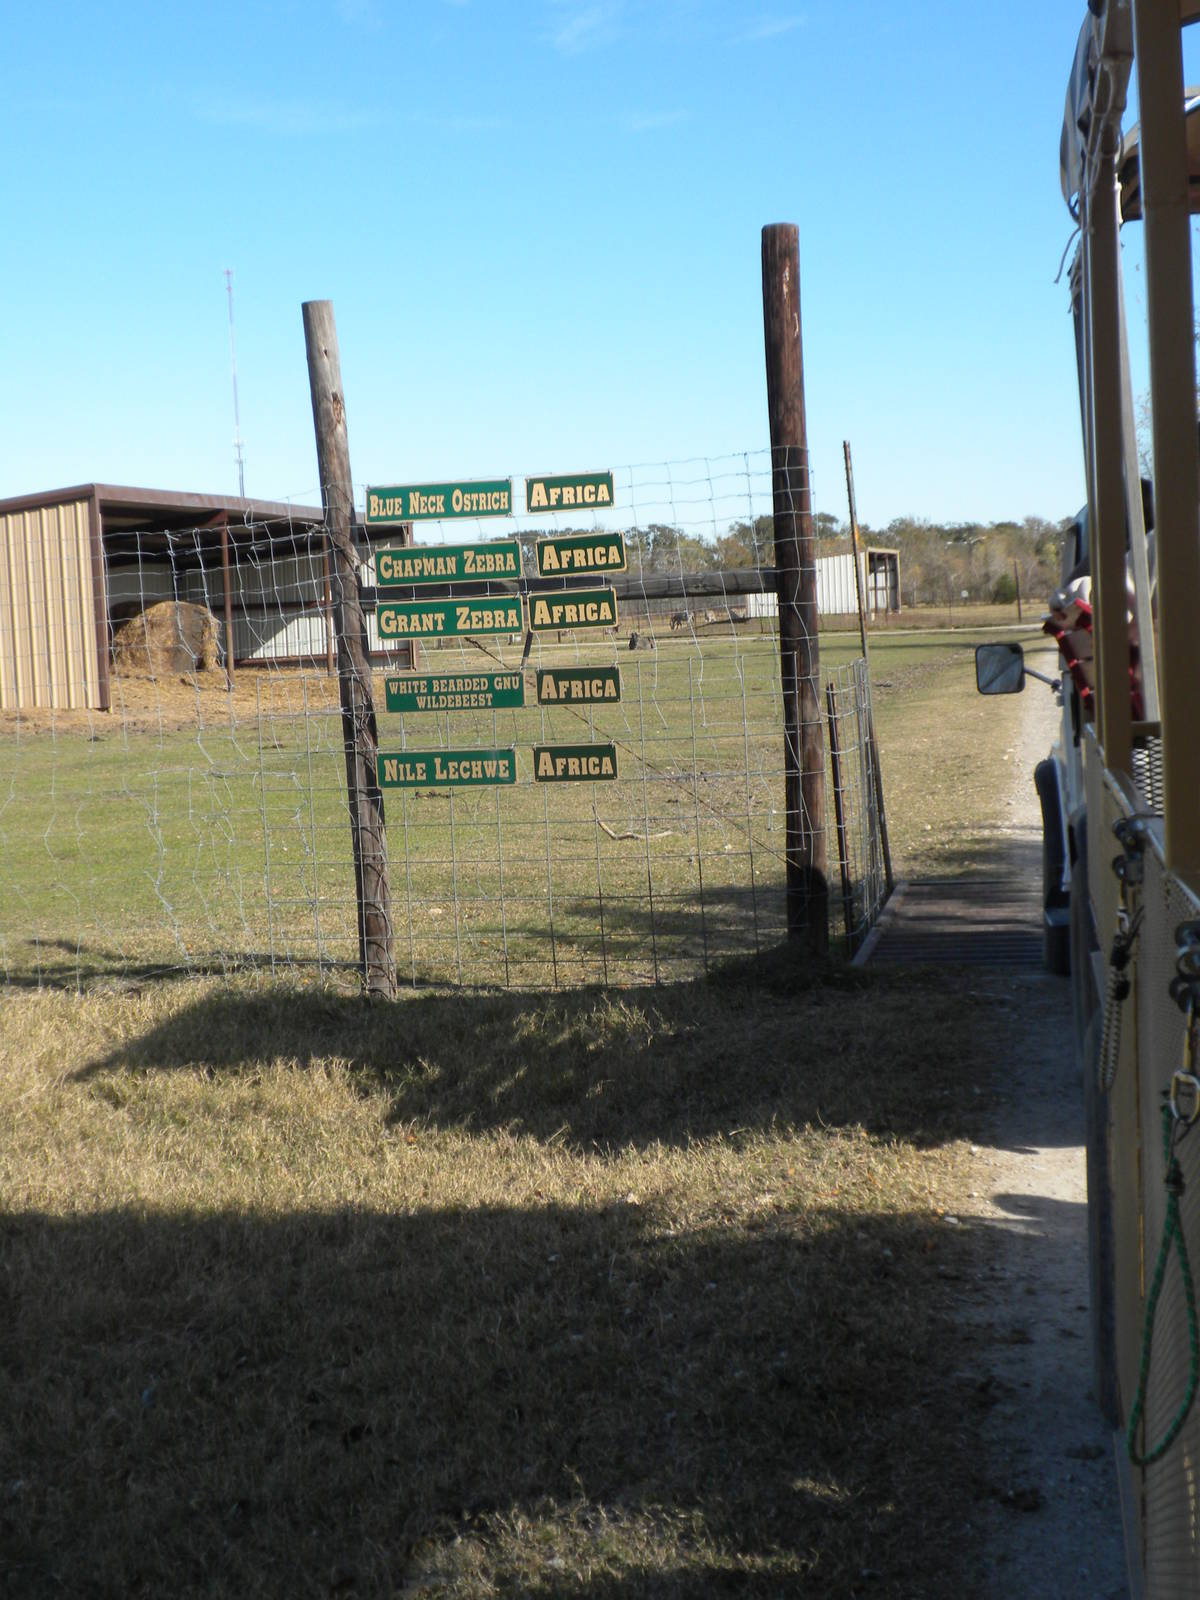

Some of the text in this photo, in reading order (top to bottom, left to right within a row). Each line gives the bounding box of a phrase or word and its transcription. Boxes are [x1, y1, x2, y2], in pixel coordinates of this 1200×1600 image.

[370, 488, 509, 516] BLUE NECK OSTRICH
[530, 482, 611, 507] AFRICA
[380, 550, 517, 579] CHAPMAN ZEBRA
[542, 545, 621, 570] AFRICA
[380, 606, 520, 635] GRANT ZEBRA
[534, 600, 613, 625] AFRICA
[388, 676, 520, 695] WHITE BEARDED GNU
[541, 674, 617, 699] AFRICA
[416, 693, 493, 709] WILDEBEEST
[384, 757, 510, 782] NILE LECHWE
[538, 752, 614, 777] AFRICA
